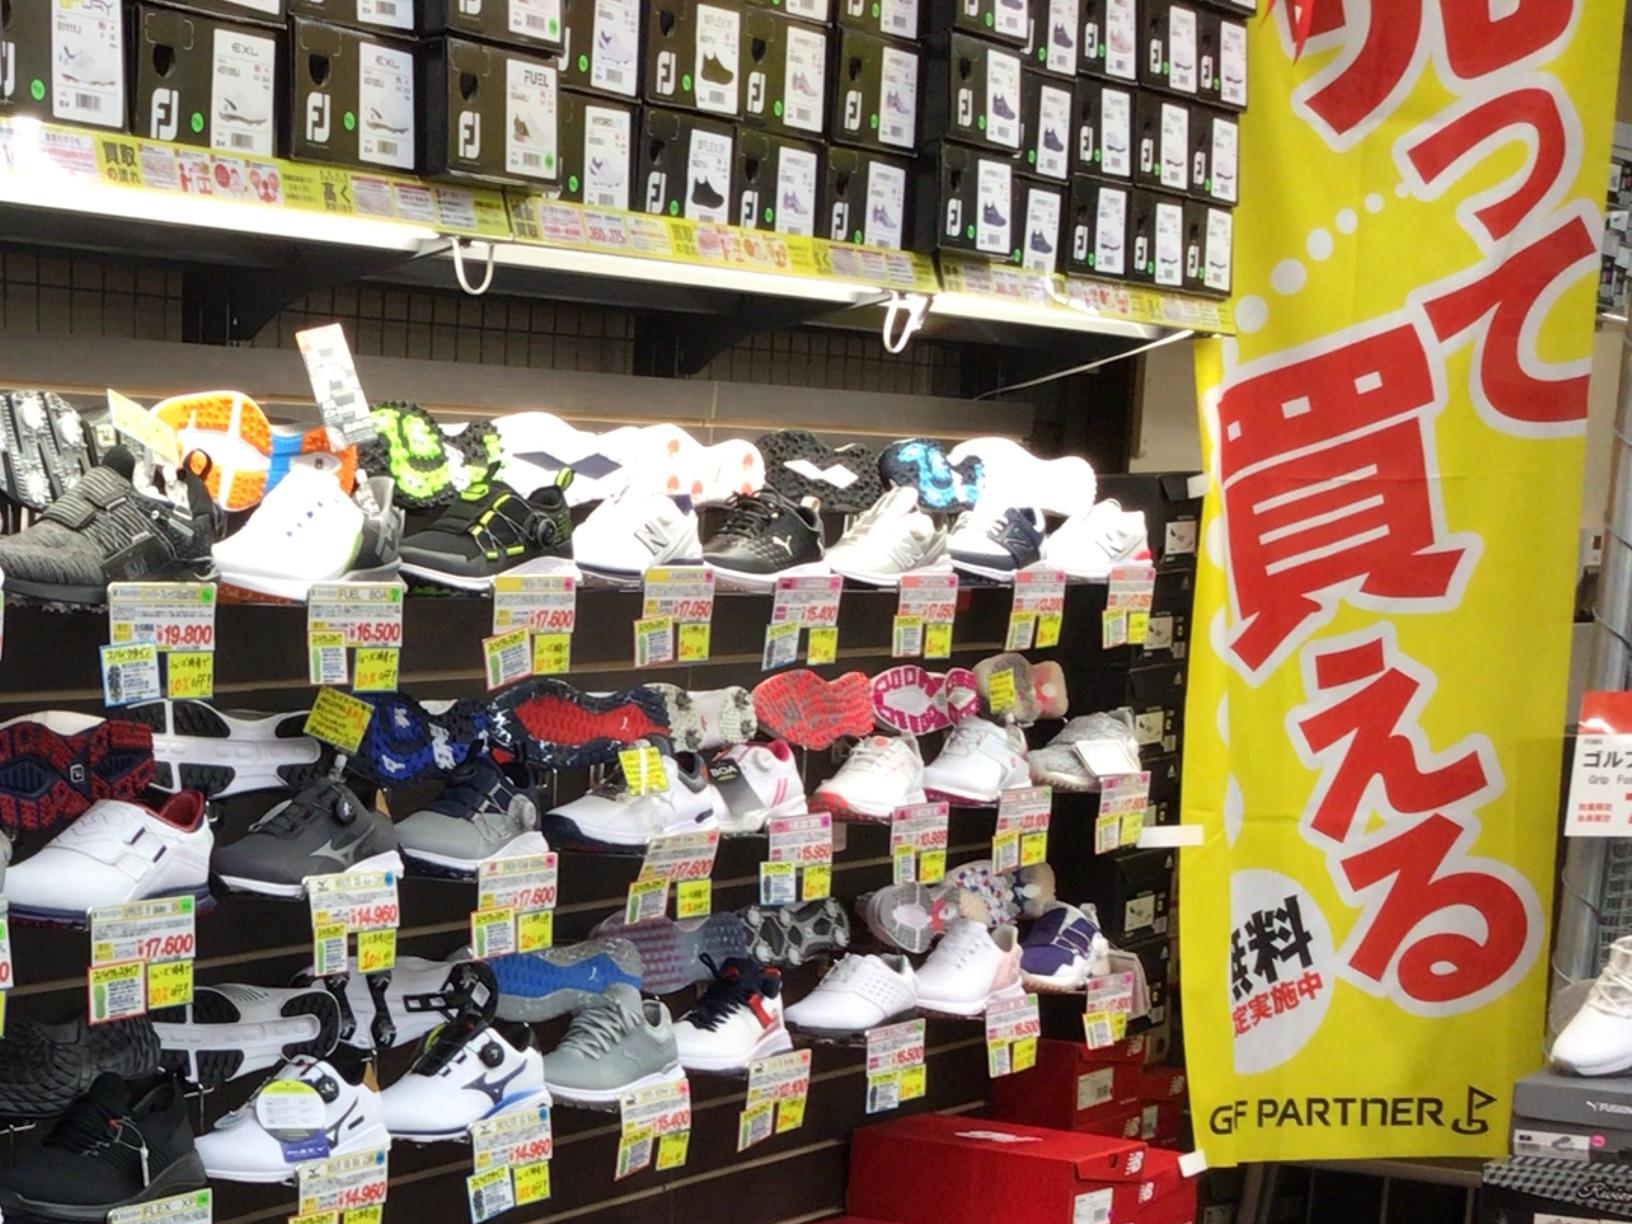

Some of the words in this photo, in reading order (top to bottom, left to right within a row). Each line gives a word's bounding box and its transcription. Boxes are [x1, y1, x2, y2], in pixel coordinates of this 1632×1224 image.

[101, 141, 138, 165] 買取
[156, 623, 213, 645] ¥19,800
[349, 622, 400, 642] ¥16,500
[1588, 775, 1610, 785] Grip
[137, 933, 194, 958] ¥17,600
[1209, 1101, 1247, 1136] GF
[1256, 1096, 1445, 1129] PARTNER
